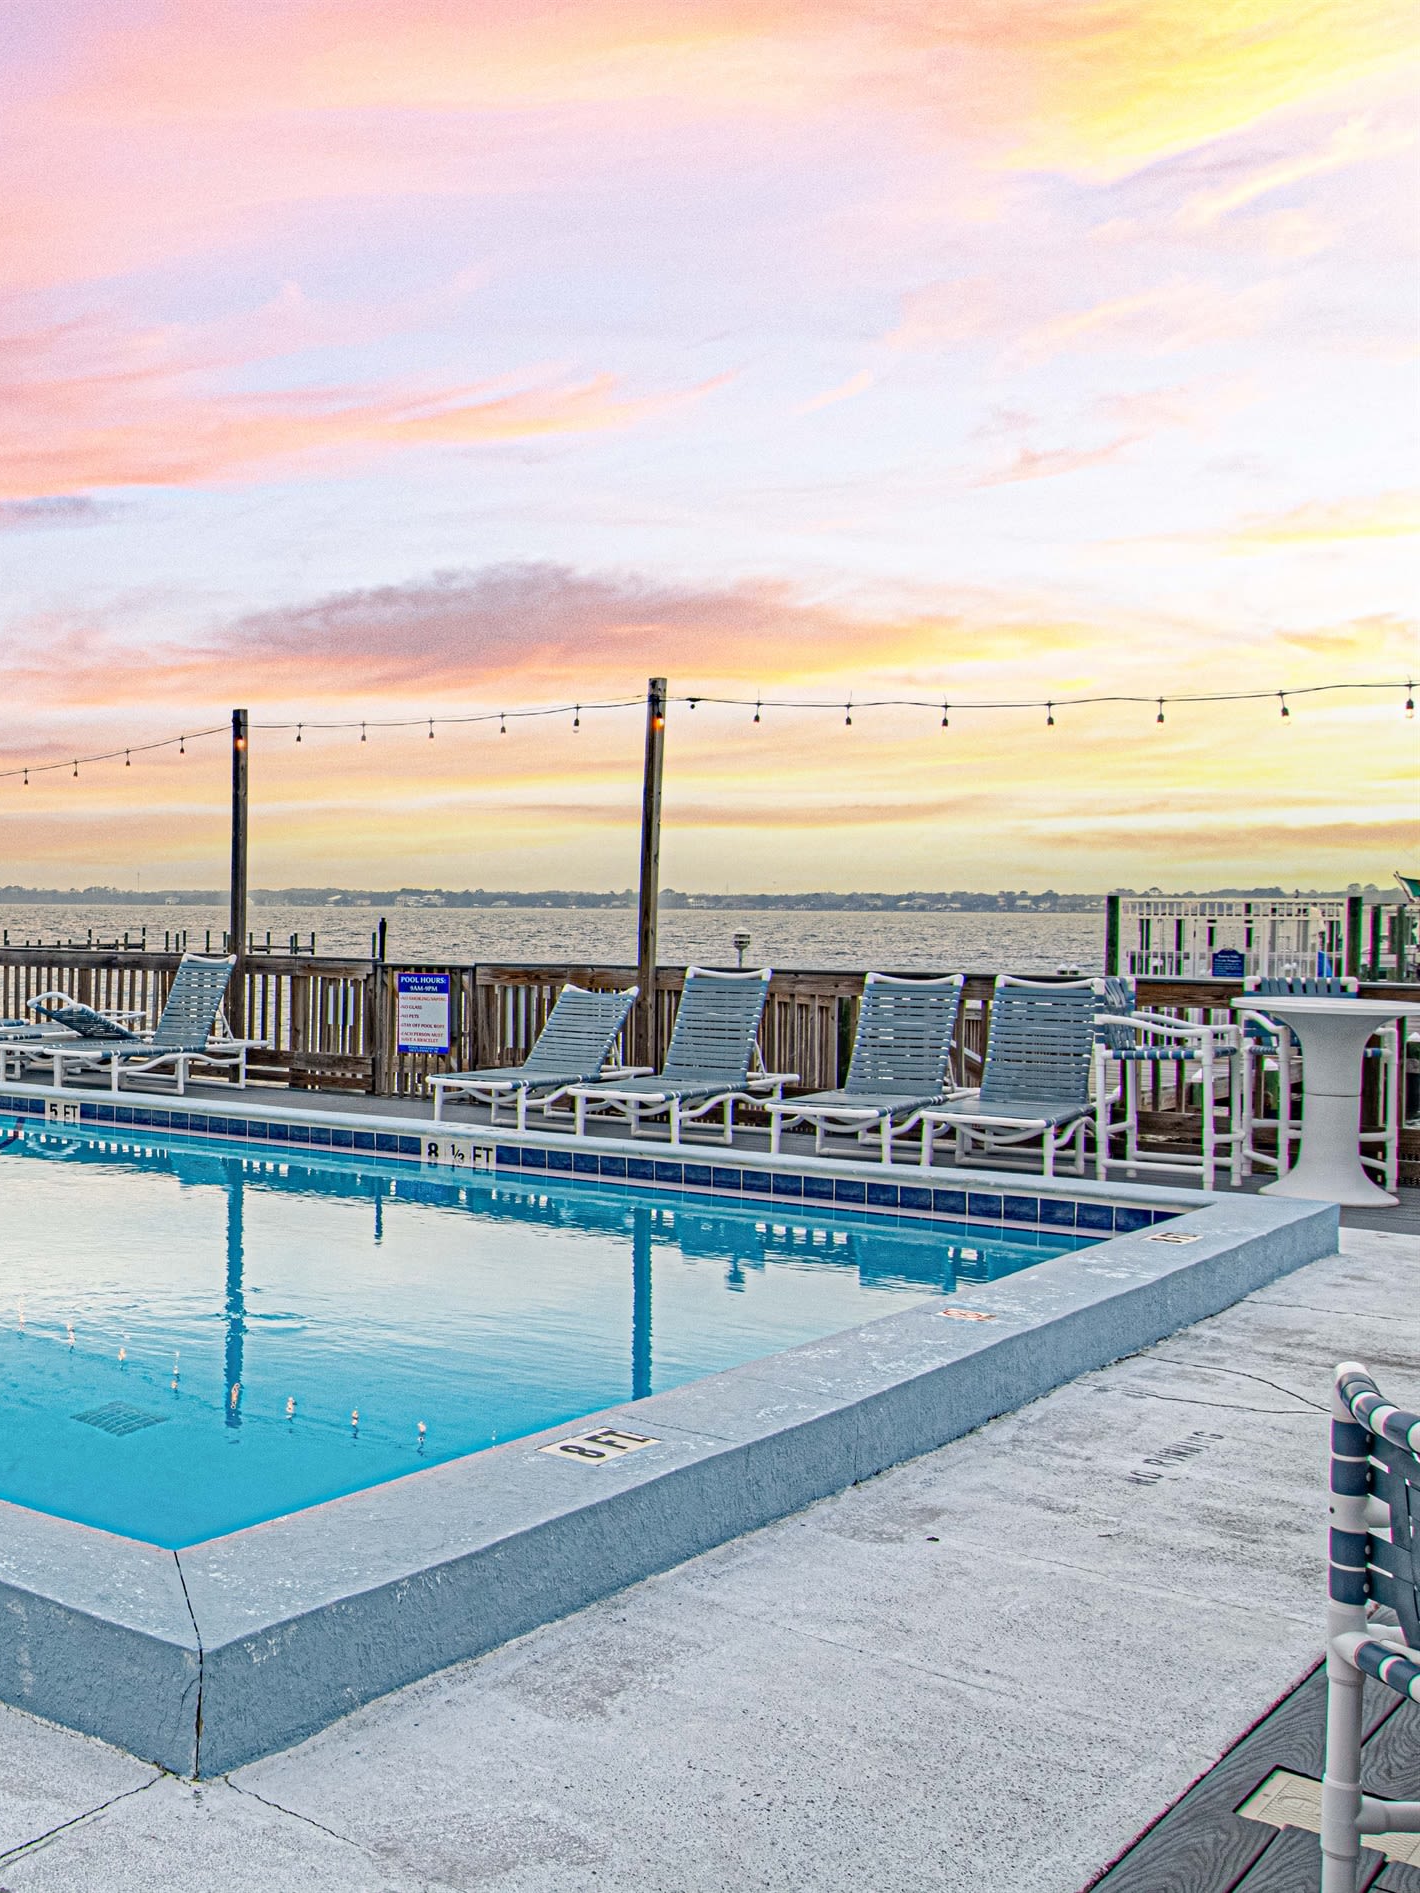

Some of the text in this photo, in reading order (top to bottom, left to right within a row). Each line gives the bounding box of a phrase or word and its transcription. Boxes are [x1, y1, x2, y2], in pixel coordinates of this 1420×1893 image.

[400, 976, 447, 984] POOL HOURS:
[49, 1103, 78, 1118] 5 FT
[427, 1142, 439, 1158] 8
[472, 1145, 493, 1163] FT
[559, 1444, 606, 1459] 8
